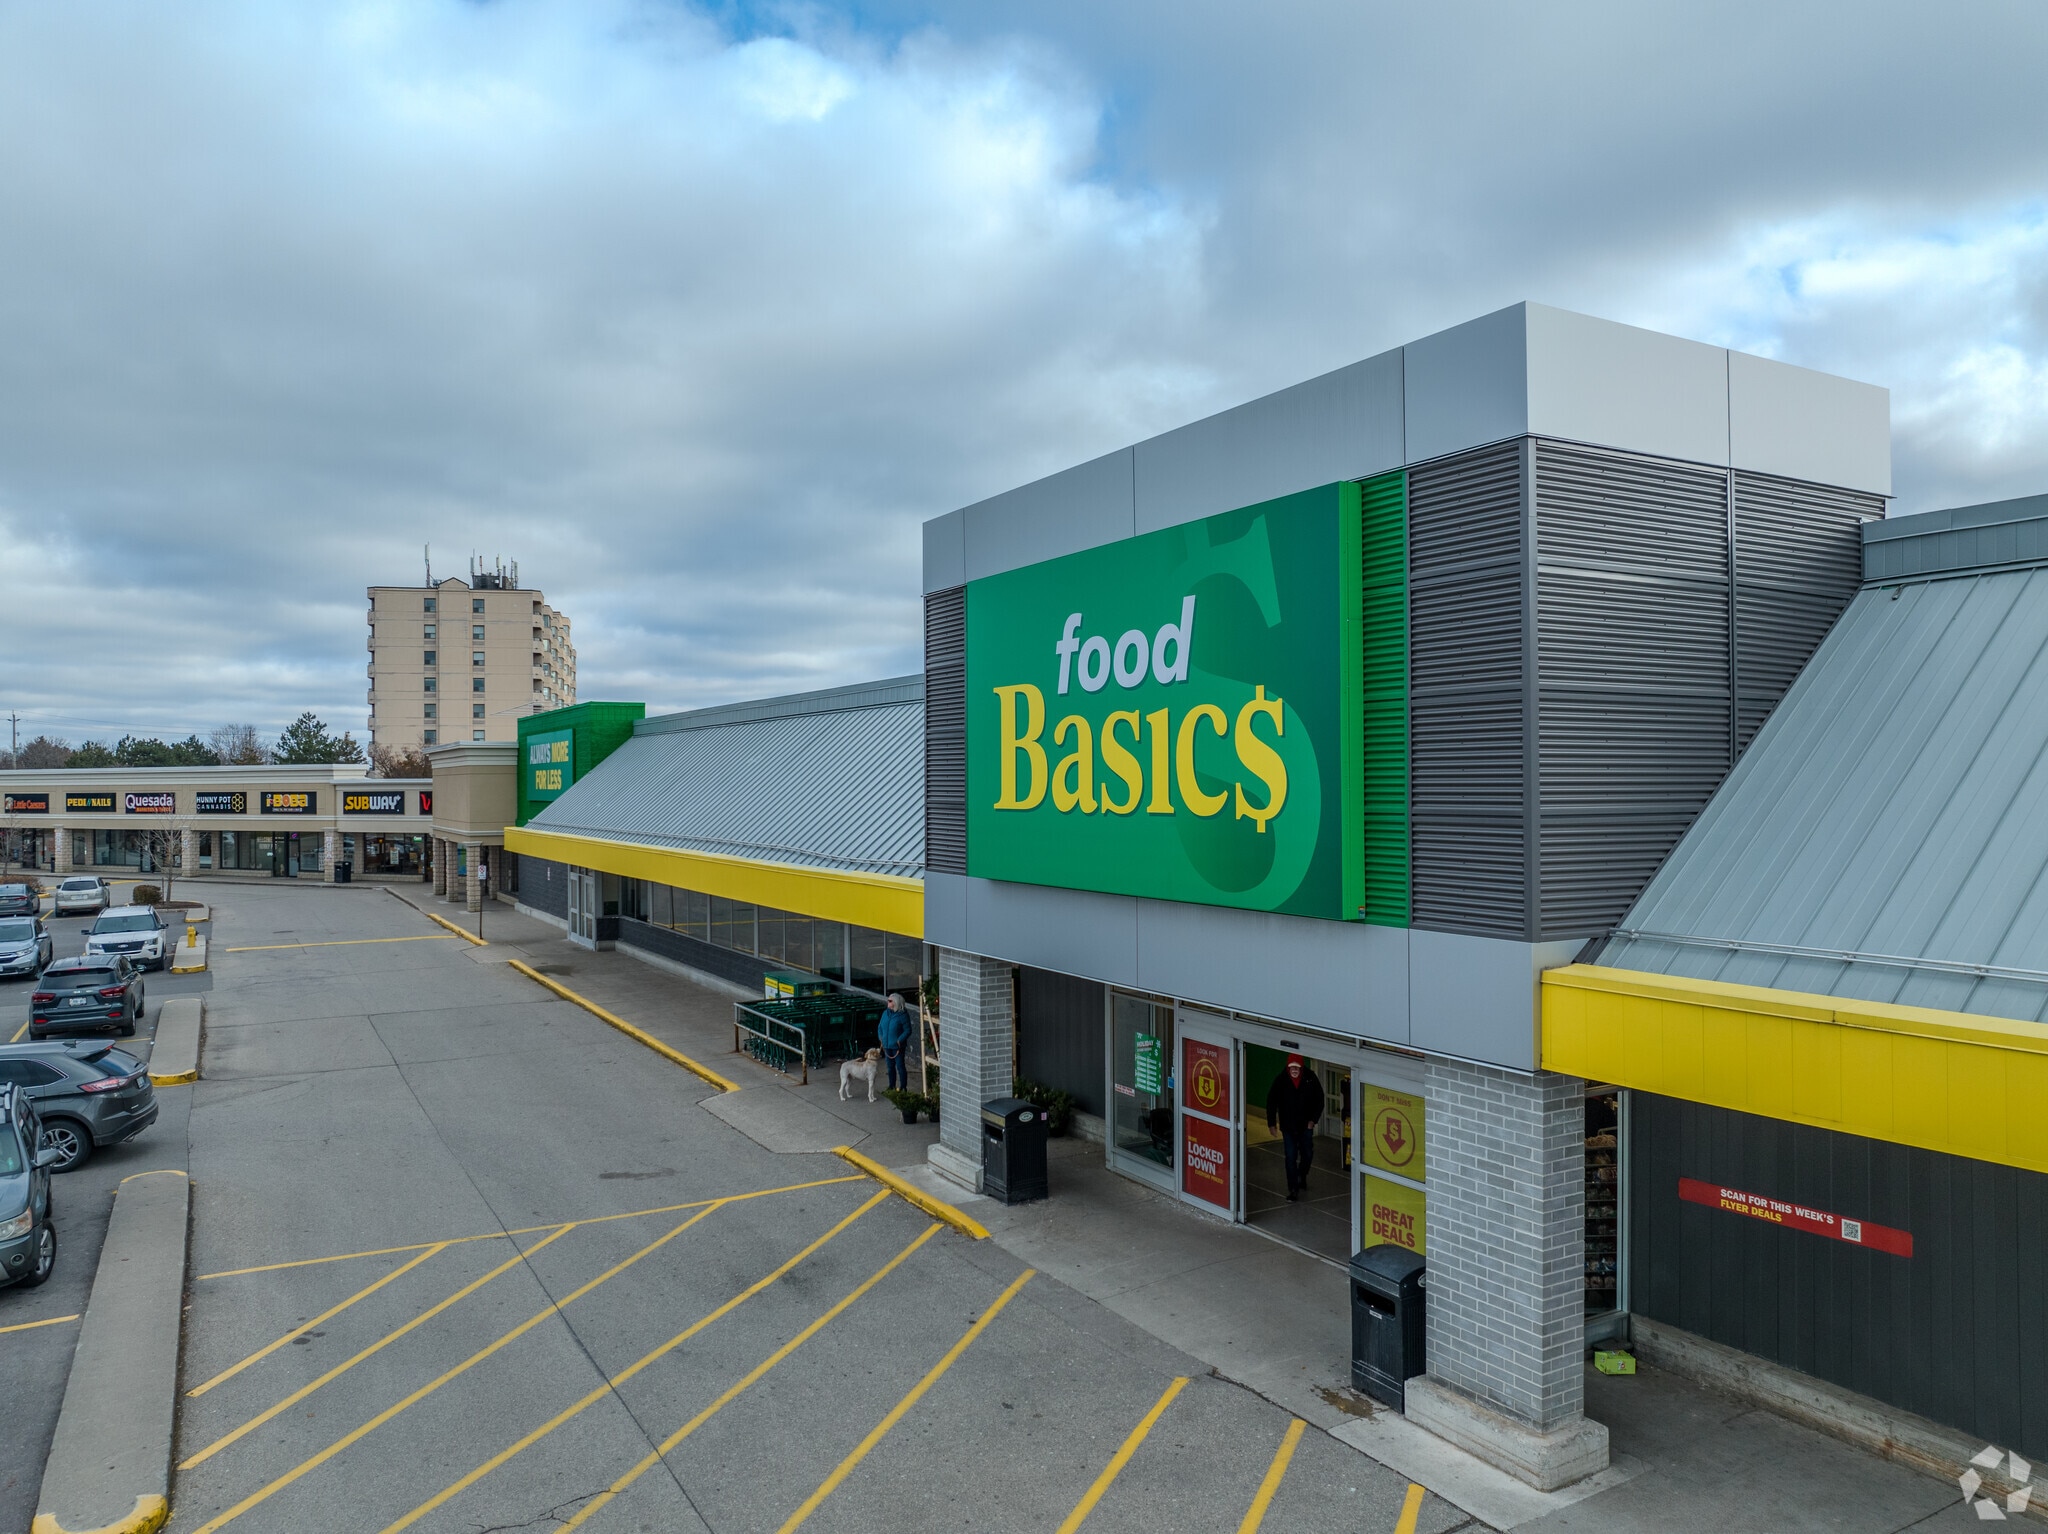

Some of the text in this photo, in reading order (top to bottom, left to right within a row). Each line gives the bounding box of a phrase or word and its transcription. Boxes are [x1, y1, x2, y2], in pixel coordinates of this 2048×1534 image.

[1056, 595, 1196, 694] food
[552, 740, 569, 762] MORE
[536, 769, 562, 790] FOR LESS
[14, 800, 26, 809] Little
[67, 798, 86, 806] PEDI
[92, 798, 111, 806] NAILS
[126, 794, 173, 809] Quesada
[344, 793, 401, 811] SUBWAY
[1197, 1048, 1208, 1056] LOOK
[1378, 1092, 1412, 1107] DON'T MISS
[1188, 1142, 1224, 1164] LOCKED
[1188, 1154, 1216, 1175] DOWN
[1372, 1204, 1414, 1230] GREAT
[1720, 1189, 1834, 1224] SCAN FOR THIS WEEK'S
[1720, 1199, 1782, 1222] FLYER DEALS
[1372, 1219, 1416, 1248] DEALS
